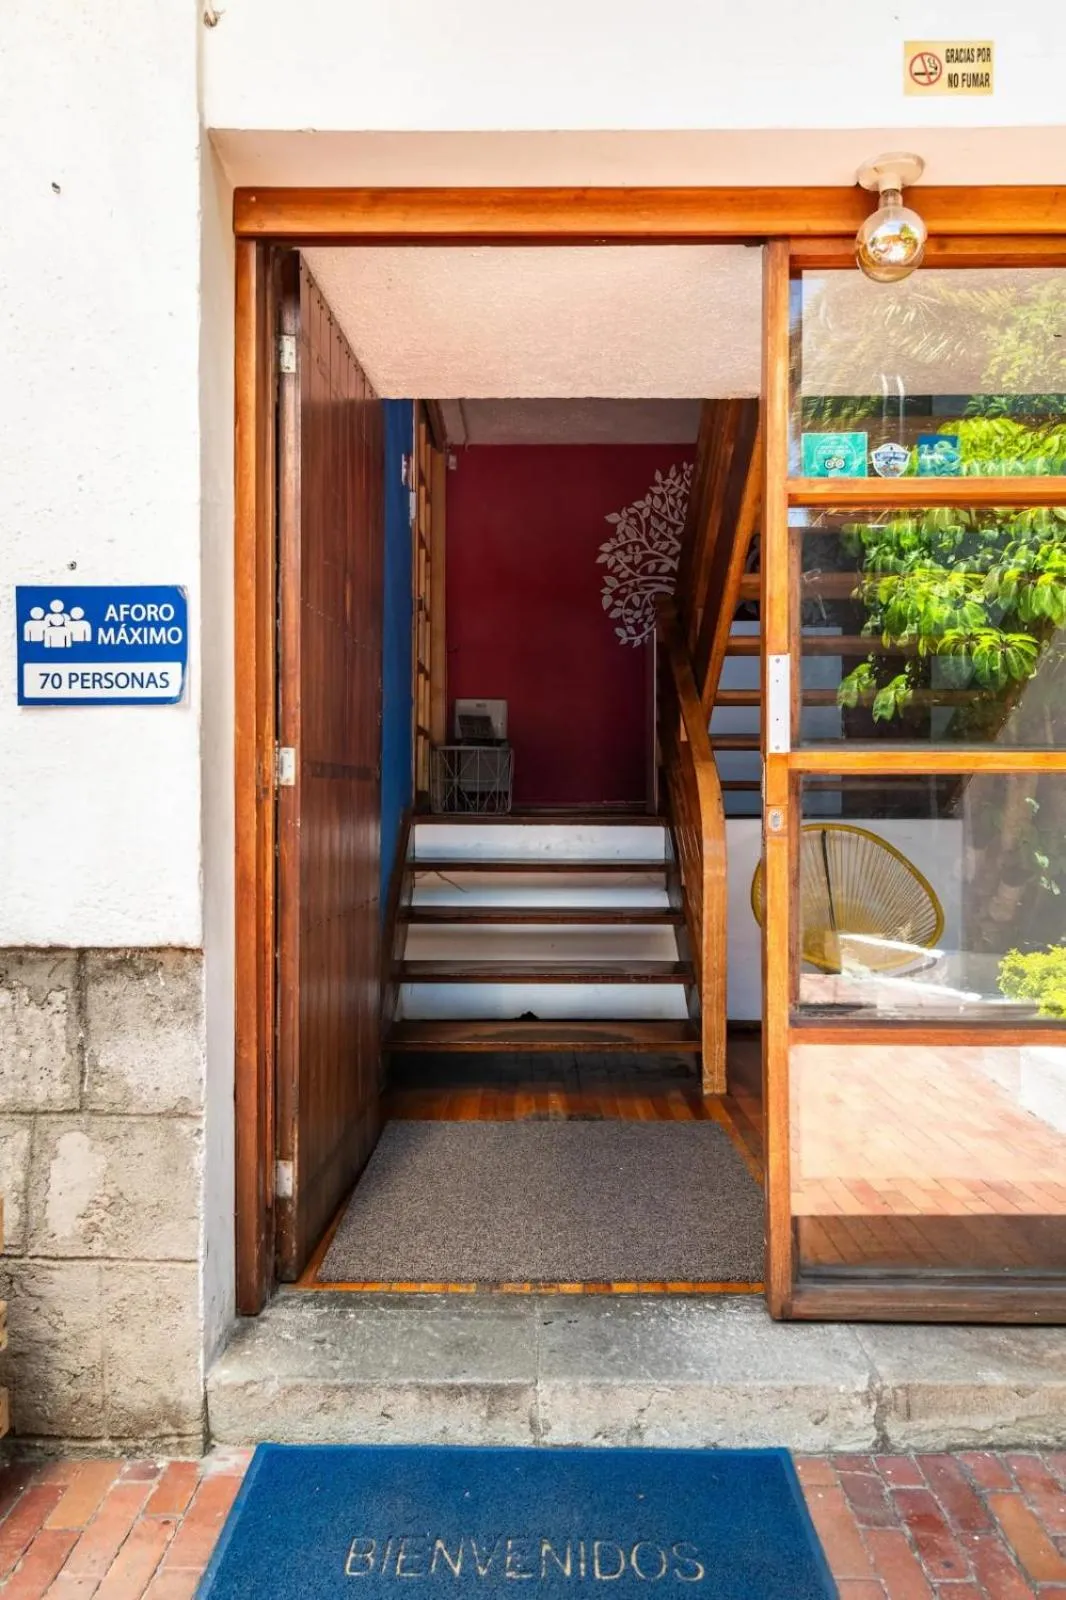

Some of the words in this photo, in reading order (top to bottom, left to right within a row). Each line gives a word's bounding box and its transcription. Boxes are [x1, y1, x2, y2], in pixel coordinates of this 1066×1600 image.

[945, 48, 975, 63] GRACIAS
[976, 47, 992, 62] POR
[947, 72, 959, 88] NO
[961, 72, 990, 88] FUMAR
[105, 604, 174, 621] AFORO
[98, 624, 183, 645] MÁXIMO
[39, 672, 62, 689] 70
[68, 672, 170, 689] PERSONAS
[344, 1535, 705, 1582] BIENVENIDOS
